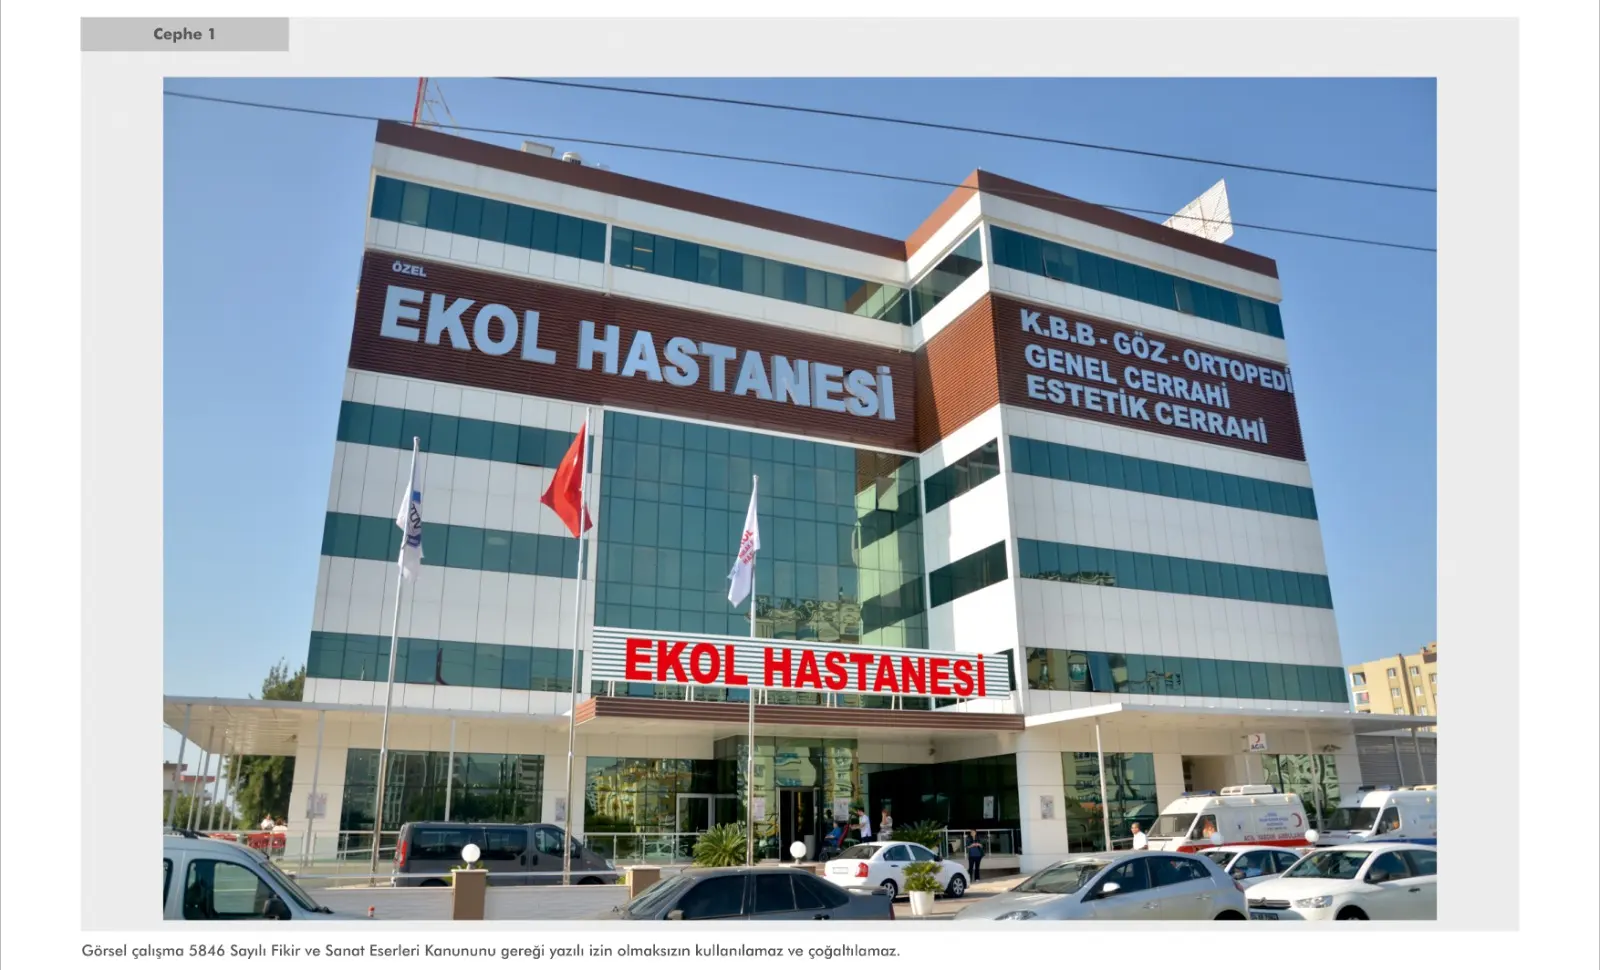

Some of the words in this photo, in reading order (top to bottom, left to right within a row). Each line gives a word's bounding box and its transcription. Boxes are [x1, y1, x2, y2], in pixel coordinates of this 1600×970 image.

[392, 261, 427, 278] ÖZEL
[380, 285, 557, 365] EKOL
[578, 320, 896, 421] HASTANESİ
[1020, 309, 1096, 347] K.B.B
[1113, 329, 1169, 365] GÖZ
[1183, 349, 1294, 393] ORTOPEDİ
[1024, 344, 1118, 385] GENEL
[1124, 365, 1231, 408] CERRAHİ
[1026, 375, 1150, 421] ESTETİK
[1154, 400, 1268, 444] CERRAHİ
[624, 637, 749, 686] EKOL
[763, 648, 987, 698] HASTANESİ
